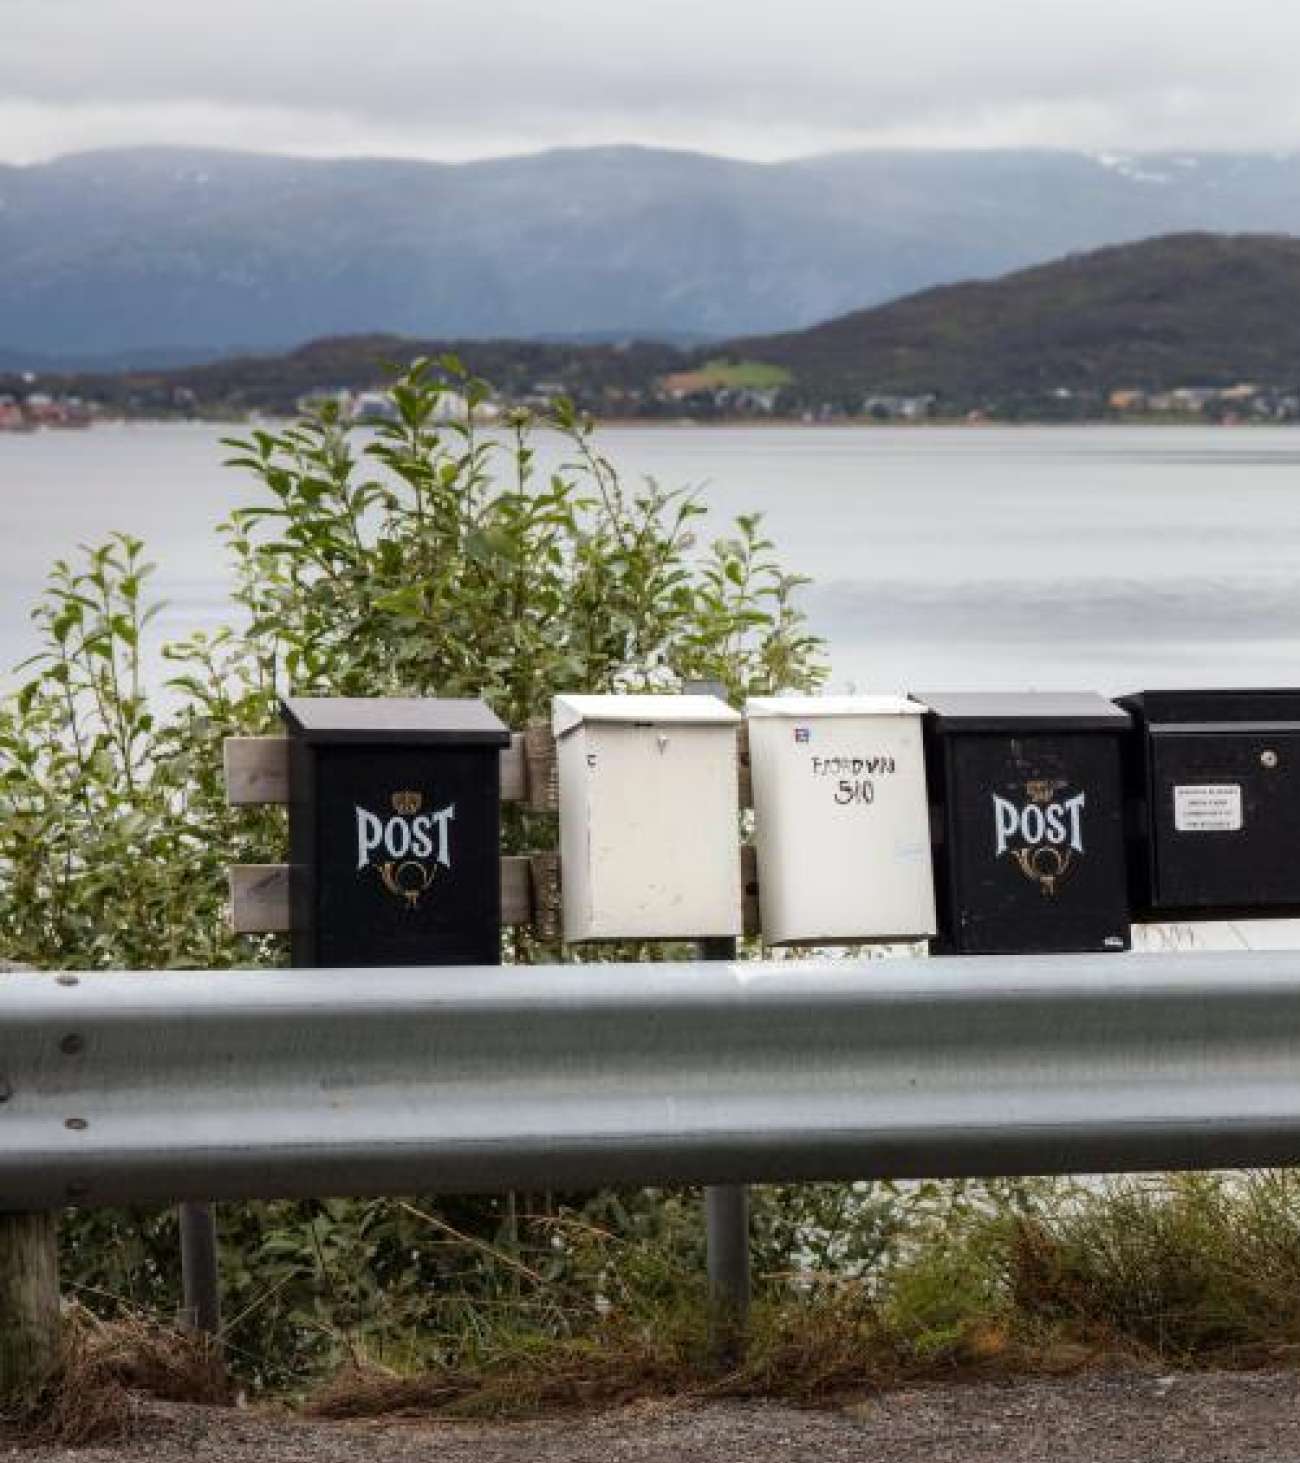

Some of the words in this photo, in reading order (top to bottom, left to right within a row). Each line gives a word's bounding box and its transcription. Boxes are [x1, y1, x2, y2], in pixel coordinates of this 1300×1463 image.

[834, 780, 874, 805] 510
[992, 790, 1085, 857] POST
[356, 804, 455, 869] POST
